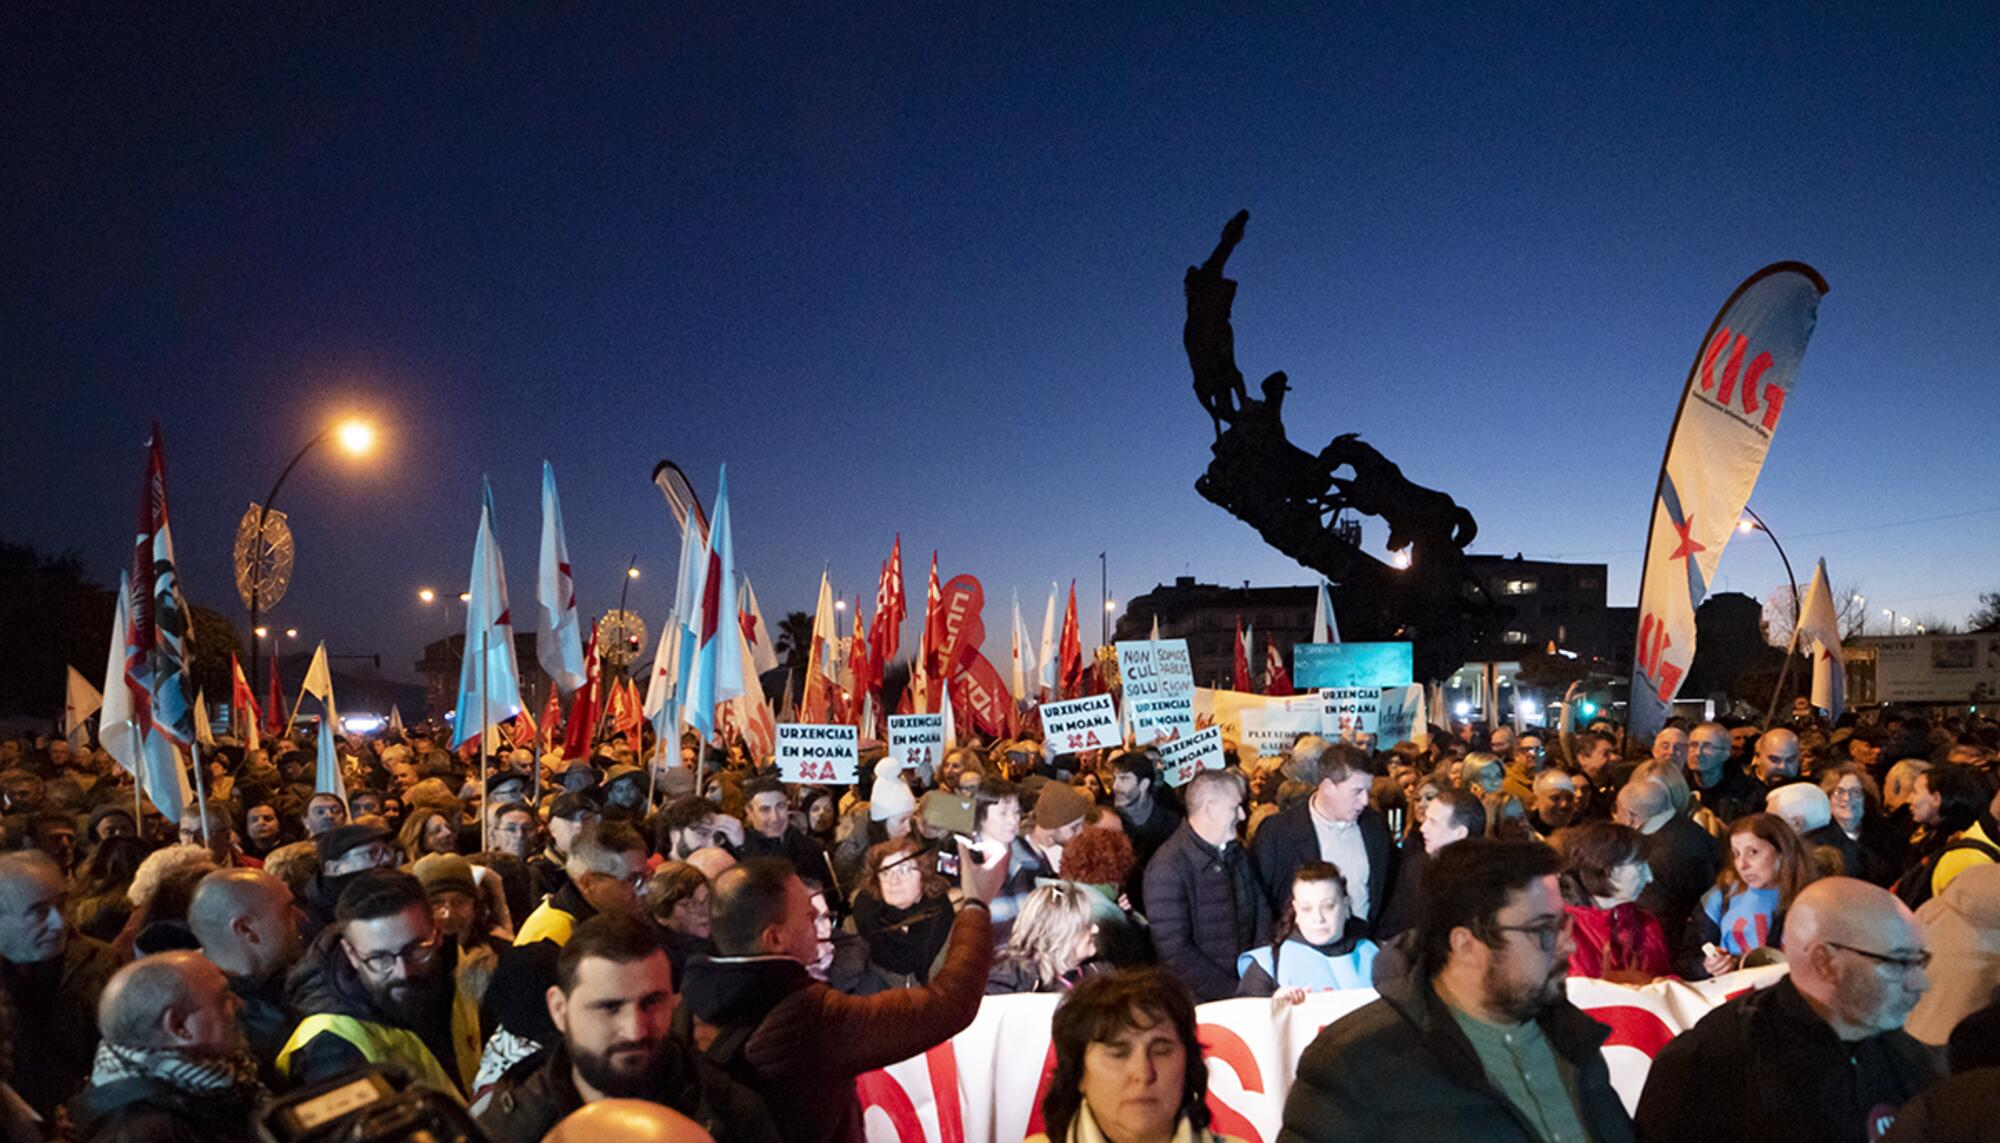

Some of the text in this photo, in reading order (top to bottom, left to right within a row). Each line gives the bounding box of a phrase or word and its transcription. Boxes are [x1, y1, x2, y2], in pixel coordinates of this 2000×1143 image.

[1124, 648, 1187, 664] NON SOMOS
[1128, 664, 1157, 680] CUL
[1126, 682, 1158, 697] SOLU
[1322, 690, 1379, 700] URXENCIAS
[1044, 699, 1110, 717] URXENCIAS
[1136, 699, 1190, 712] URXENCIAS
[1325, 705, 1337, 714] EN
[891, 717, 942, 728] URXENCIAS
[1050, 715, 1112, 733] EN MOAÑA
[1140, 718, 1153, 727] EN
[780, 728, 854, 740] URXENCIAS
[893, 735, 906, 745] EN
[1160, 729, 1218, 757] URXENCIAS
[782, 744, 853, 758] EN MOAÑA
[1178, 743, 1218, 765] MOAÑA
